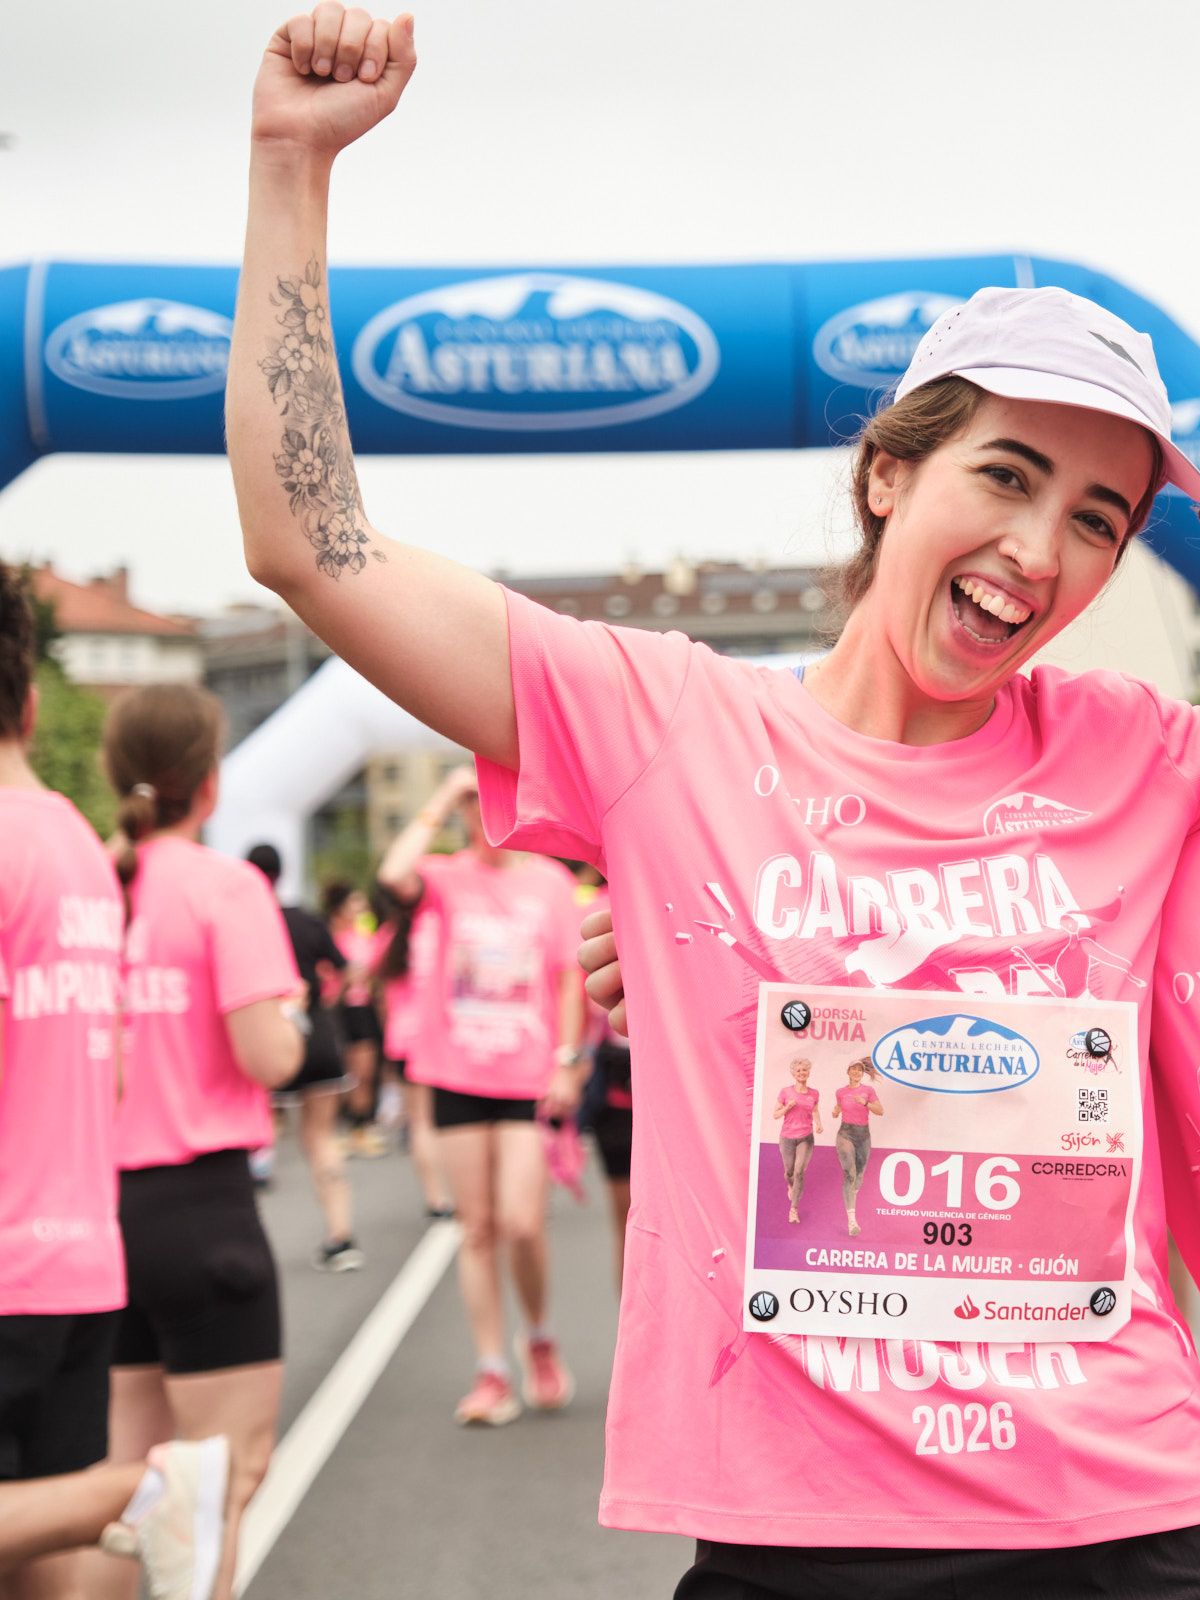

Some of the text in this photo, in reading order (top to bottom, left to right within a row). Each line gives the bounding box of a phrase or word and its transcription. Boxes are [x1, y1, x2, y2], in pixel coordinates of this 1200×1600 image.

[384, 320, 692, 395] ASTURIANA
[753, 764, 867, 827] OHO
[754, 850, 1092, 941] CARRERA
[812, 1007, 867, 1021] DORSAL
[885, 1040, 1028, 1076] ASTURIANA
[912, 1039, 1024, 1052] CENTRAL LECHERA
[1061, 1132, 1101, 1152] gijón
[879, 1151, 1021, 1211] 016
[1031, 1162, 1127, 1177] CORREDORA
[876, 1207, 1012, 1221] TELÉFONO VIOLENCIA DE GÉNERO
[923, 1221, 973, 1247] 903
[805, 1248, 888, 1269] CARRERA
[894, 1253, 917, 1270] DE
[923, 1253, 946, 1272] LA
[952, 1255, 1012, 1274] MUJER
[1028, 1253, 1079, 1276] GIJÓN
[789, 1287, 908, 1318] OYSHO
[984, 1301, 1090, 1321] Santander
[911, 1401, 1017, 1456] 2026
